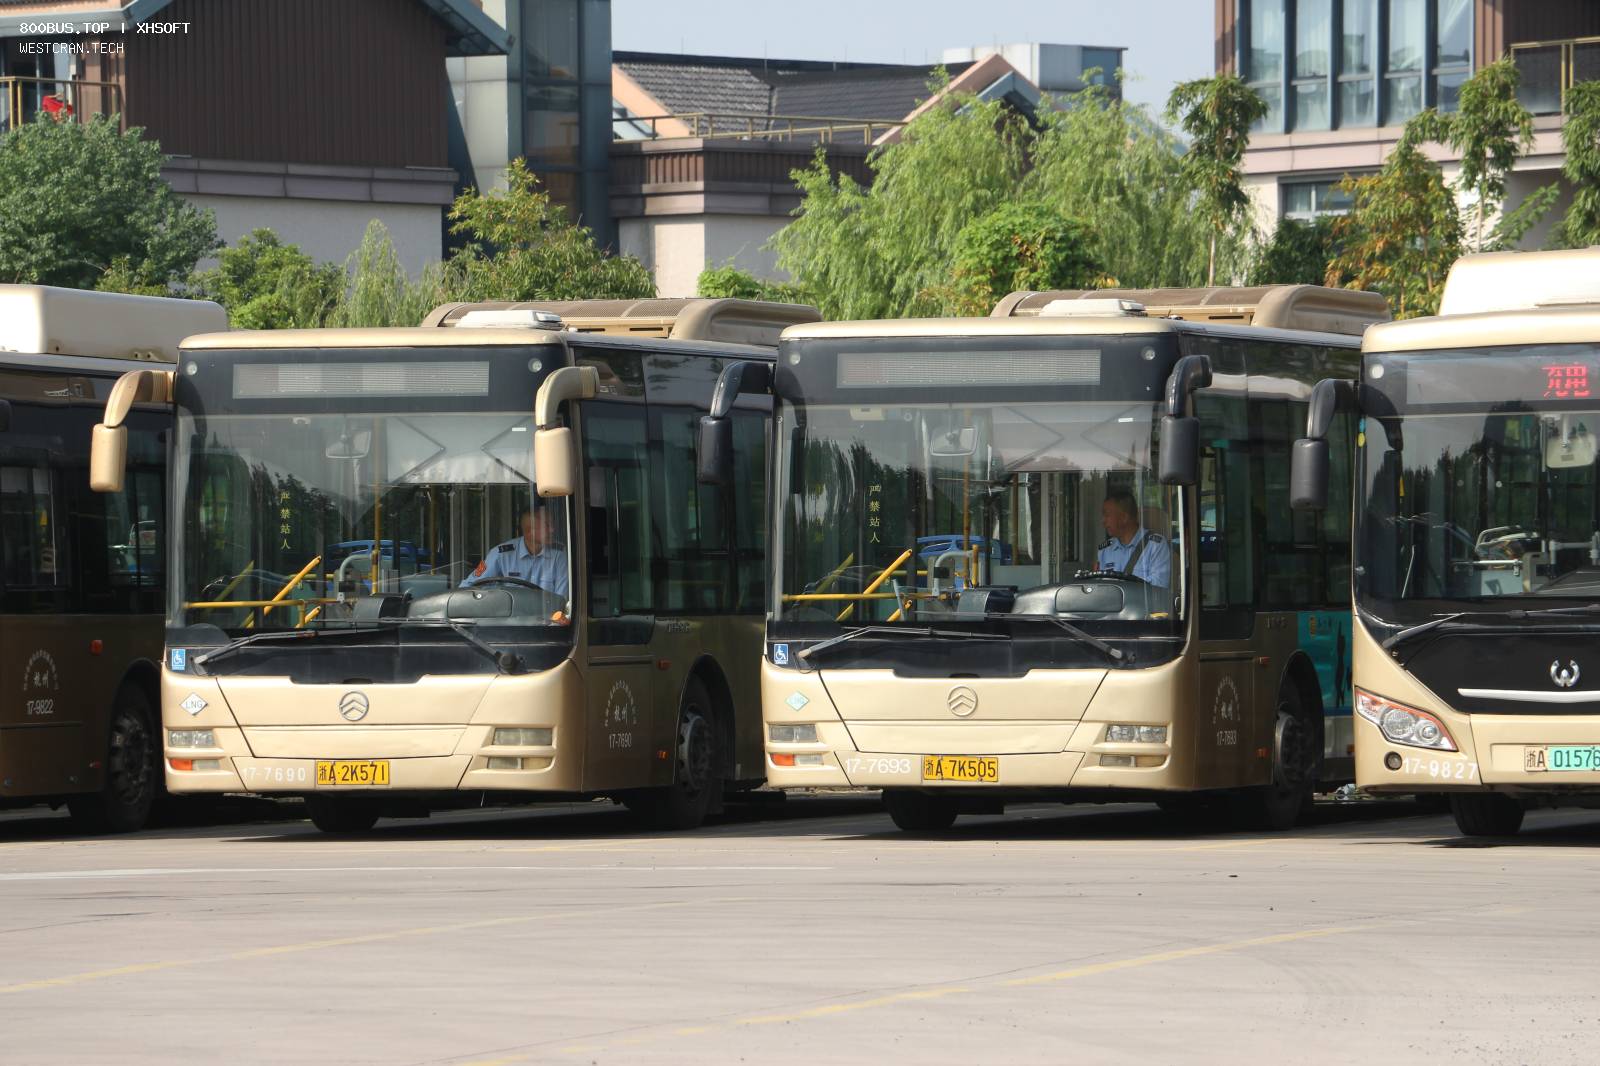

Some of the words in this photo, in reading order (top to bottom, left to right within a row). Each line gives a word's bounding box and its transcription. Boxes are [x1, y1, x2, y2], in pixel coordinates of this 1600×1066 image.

[279, 490, 291, 550] 严禁站人
[869, 484, 882, 544] 严禁站人
[26, 699, 54, 715] 17-9822
[185, 700, 203, 709] LNG
[845, 758, 911, 774] 17-7693
[1403, 757, 1478, 780] 17-9827
[243, 767, 306, 782] 17-7690
